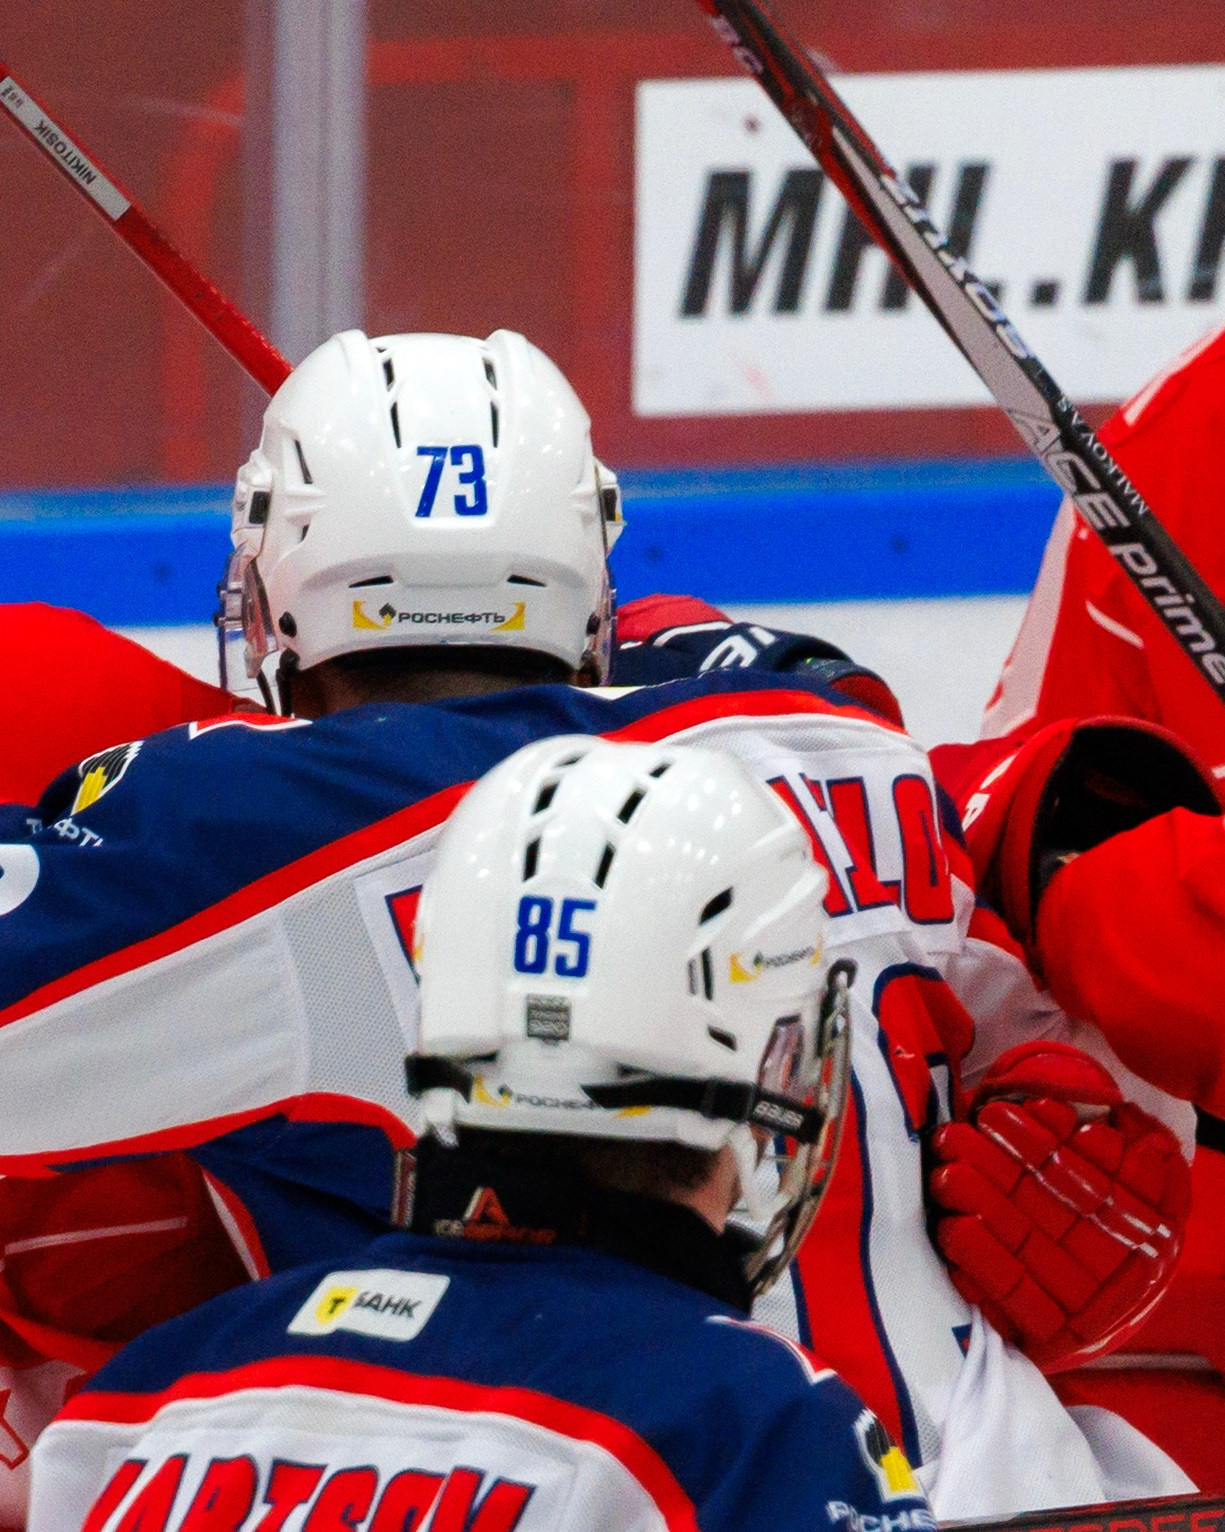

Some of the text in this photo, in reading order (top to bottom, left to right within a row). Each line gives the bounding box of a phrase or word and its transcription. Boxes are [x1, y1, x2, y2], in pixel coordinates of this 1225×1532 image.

[33, 119, 98, 186] NIKITOSIK
[415, 445, 488, 518] 73
[1004, 407, 1131, 530] ACE
[397, 611, 506, 625] РОСНЕФТЬ
[513, 894, 598, 979] 85
